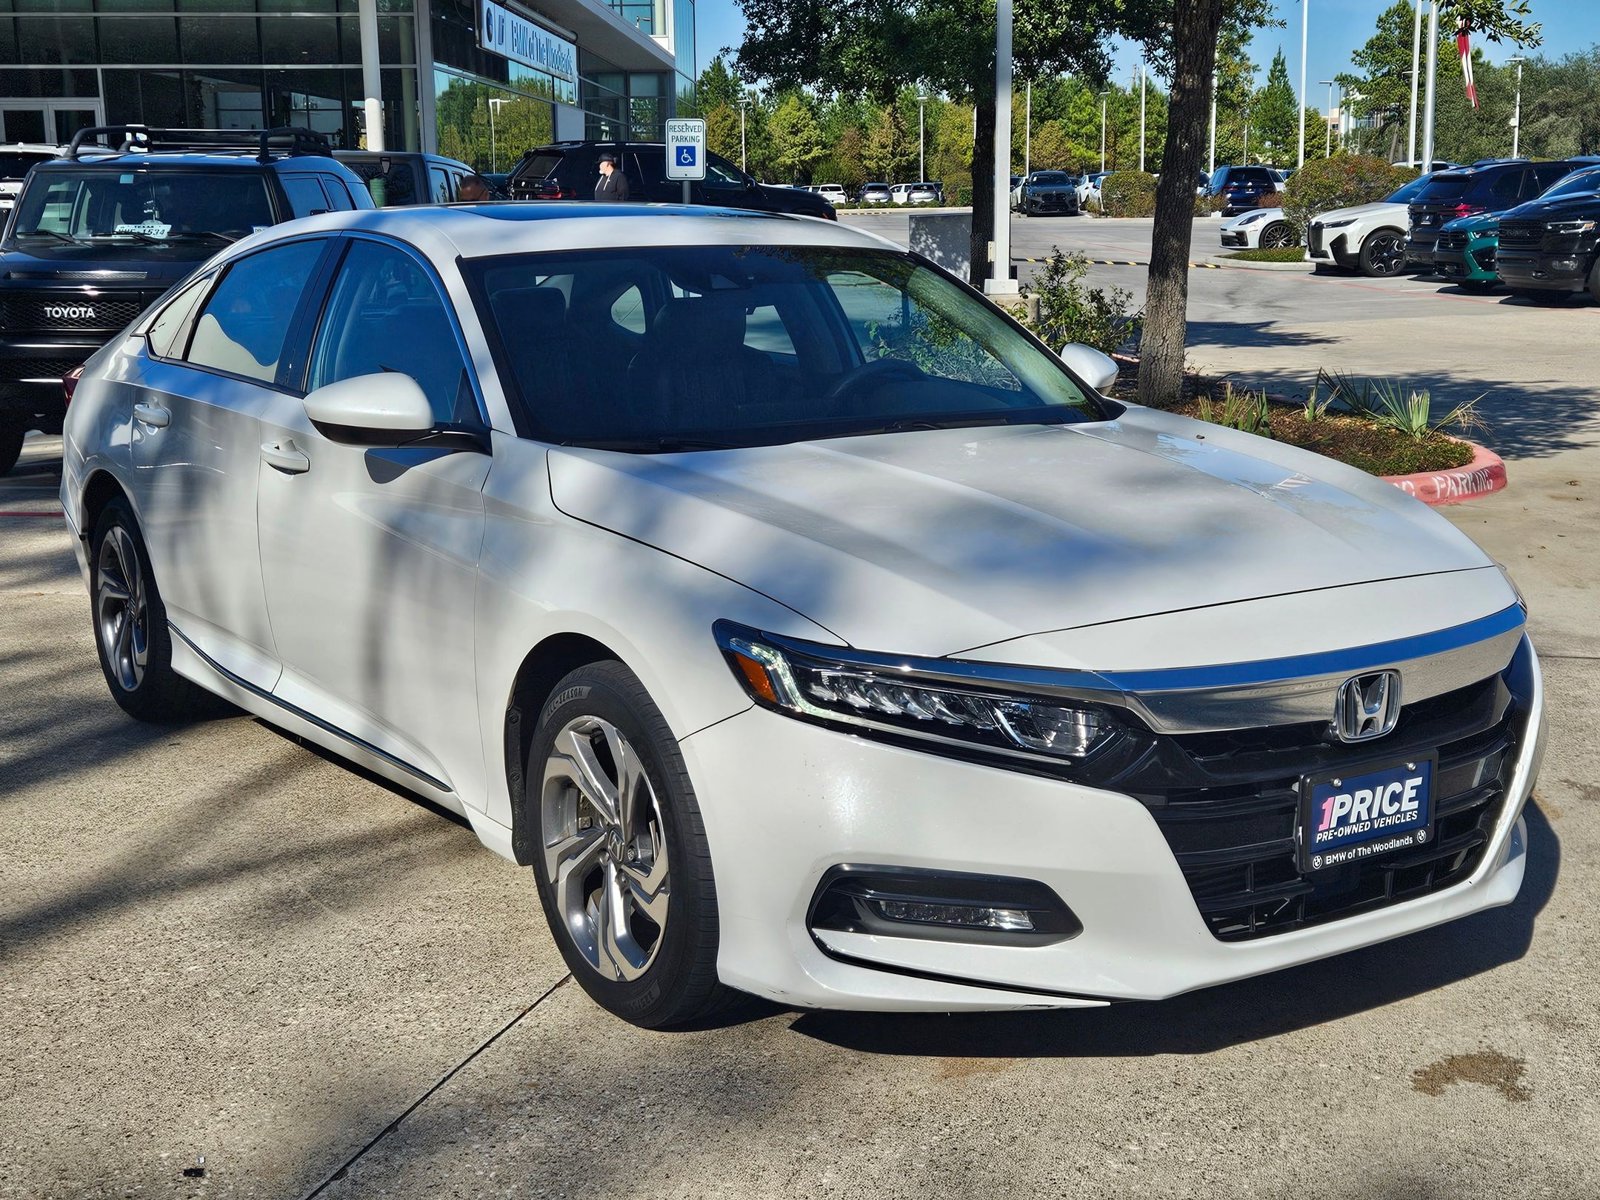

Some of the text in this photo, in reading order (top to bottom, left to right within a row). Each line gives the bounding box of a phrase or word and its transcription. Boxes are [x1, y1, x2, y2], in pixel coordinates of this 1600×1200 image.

[511, 20, 528, 57] BMW
[668, 124, 702, 133] RESERVED
[671, 135, 701, 143] PARKING
[44, 307, 96, 318] TOYOTA
[1431, 469, 1493, 498] PARKING
[1315, 811, 1418, 843] PRE-OWNED VEHICLES
[1325, 835, 1413, 865] BMW of The Woodlands
